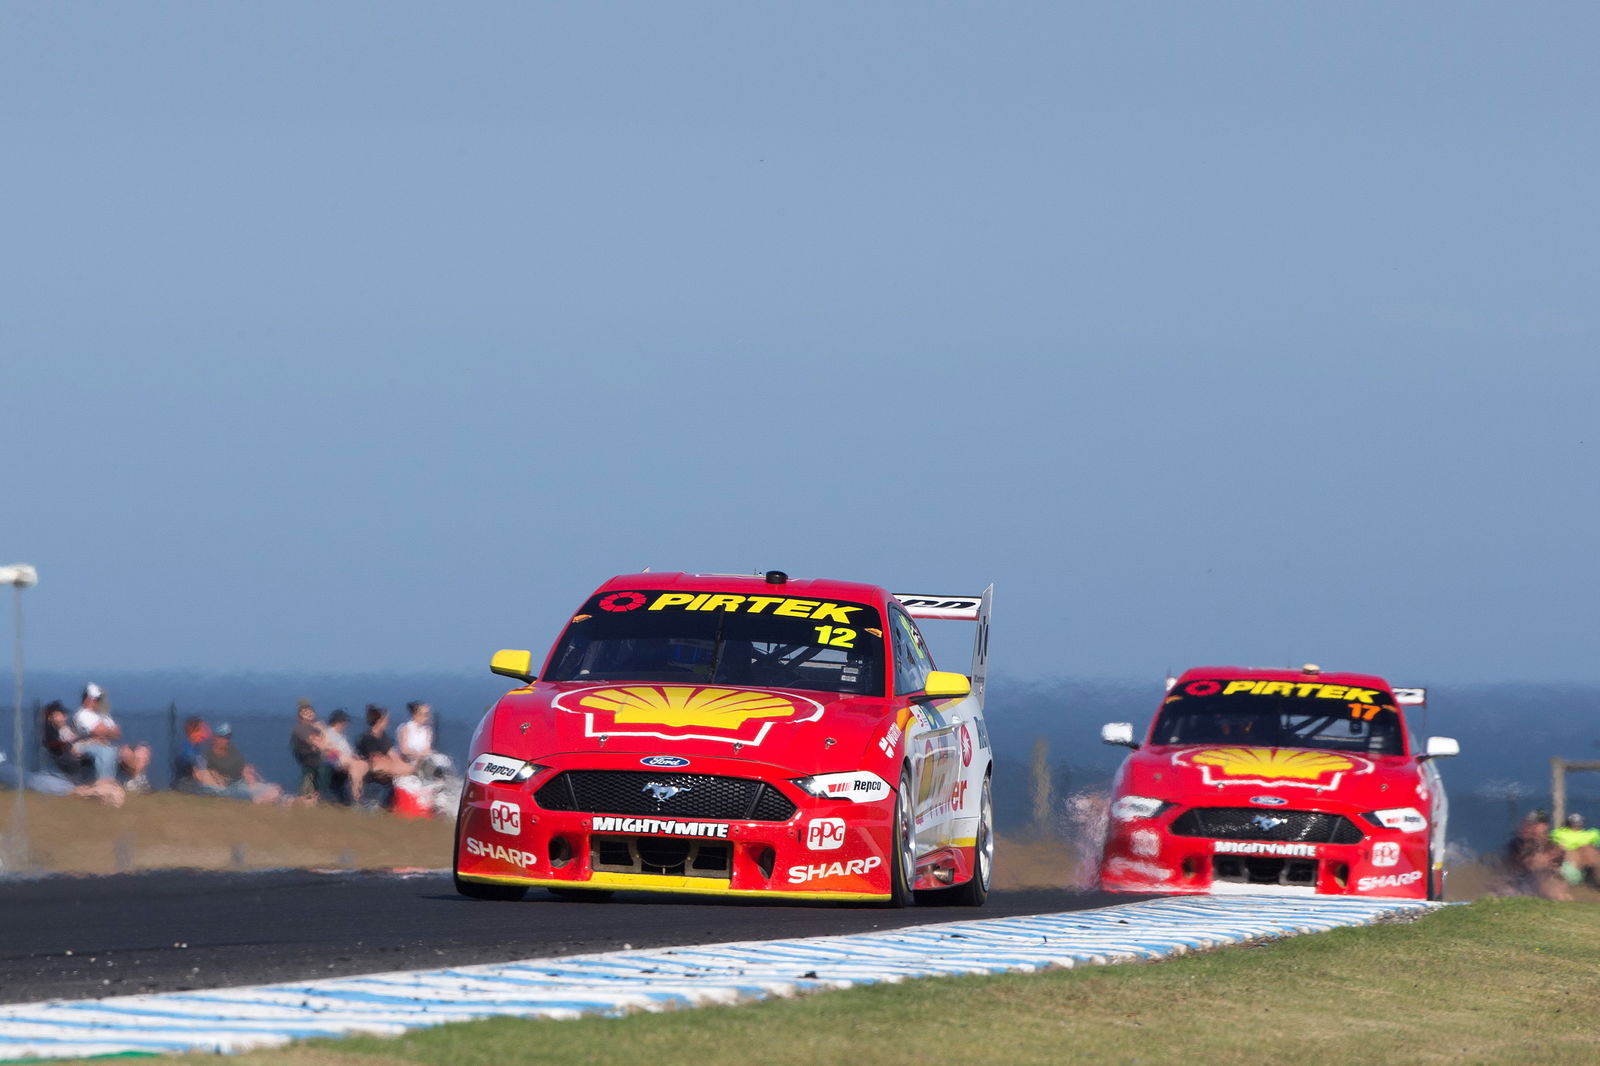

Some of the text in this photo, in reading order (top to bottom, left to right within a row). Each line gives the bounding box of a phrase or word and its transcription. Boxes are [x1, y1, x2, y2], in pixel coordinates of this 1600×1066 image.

[648, 593, 863, 624] PIRTEK
[814, 625, 857, 648] 12
[1222, 680, 1381, 704] PIRTEK
[1348, 703, 1381, 721] 17
[483, 762, 515, 777] Repco
[650, 756, 681, 767] Ford
[853, 780, 882, 792] Repco
[493, 804, 519, 830] PPG
[809, 821, 844, 846] PPG
[466, 837, 537, 868] SHARP
[788, 856, 882, 884] SHARP
[1357, 871, 1423, 891] SHARP
